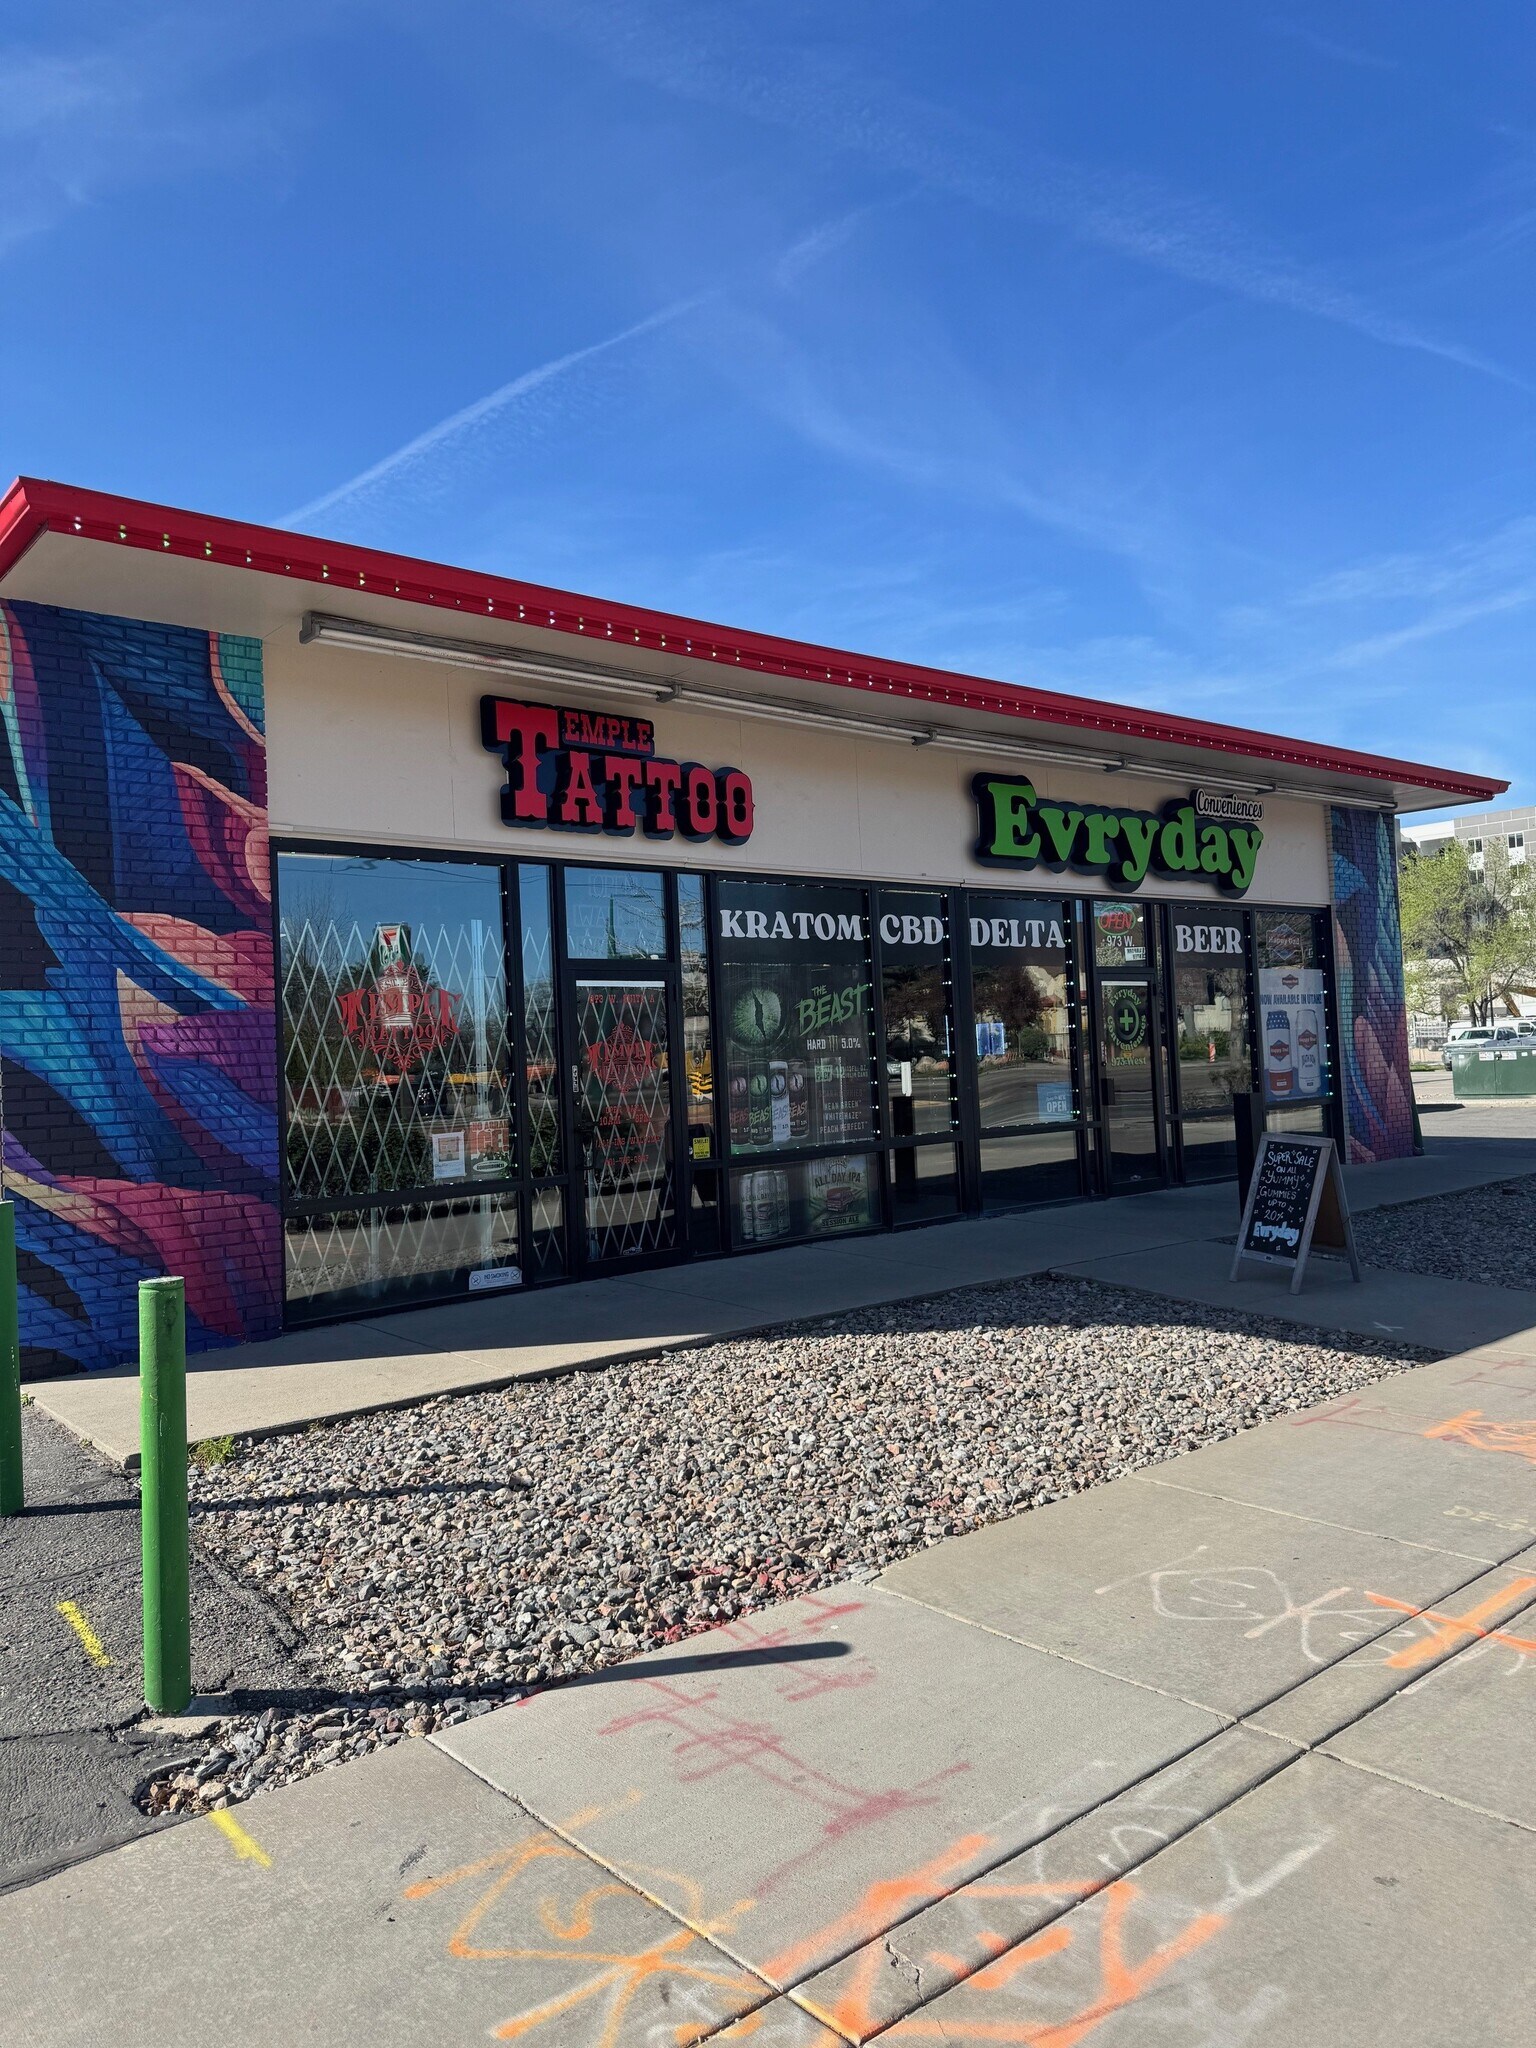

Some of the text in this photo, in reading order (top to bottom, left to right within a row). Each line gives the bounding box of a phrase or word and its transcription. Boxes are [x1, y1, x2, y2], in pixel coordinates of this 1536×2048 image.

[1197, 789, 1264, 820] Conveniences
[988, 782, 1264, 889] Evryday
[720, 908, 1067, 949] KRATOM CBD DELTA
[1100, 911, 1133, 930] OPEN
[1106, 935, 1122, 947] 973
[1175, 925, 1243, 954] BEER
[811, 985, 827, 996] THE
[1109, 988, 1142, 1007] Evryday
[796, 983, 868, 1036] BEAST
[806, 1038, 861, 1050] HARD 5.0%
[1046, 1100, 1067, 1112] OPEN
[1294, 1151, 1315, 1168] SALE
[831, 1173, 846, 1184] DAY
[848, 1172, 862, 1184] IPA
[1287, 1166, 1297, 1174] ALL
[1263, 1209, 1284, 1221] 20%
